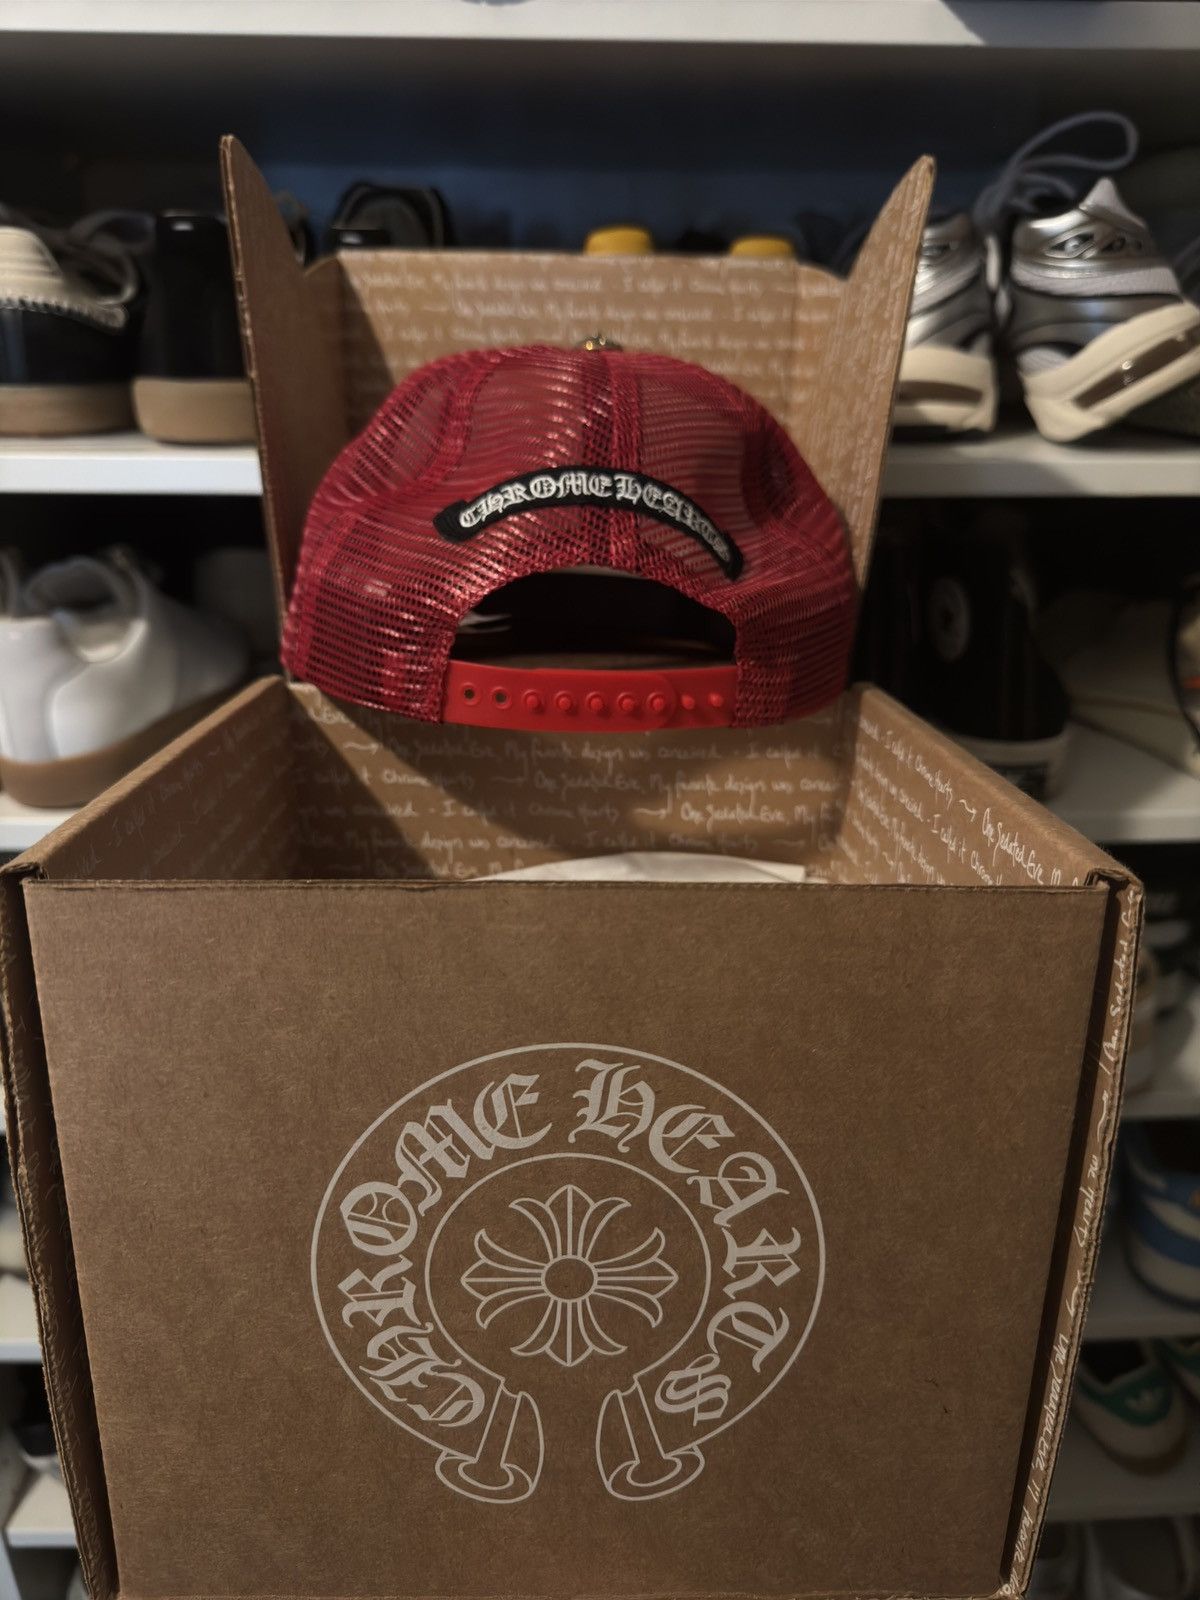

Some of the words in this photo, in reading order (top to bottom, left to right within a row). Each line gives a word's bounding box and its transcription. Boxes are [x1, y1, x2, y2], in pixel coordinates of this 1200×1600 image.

[458, 472, 613, 528] CHROME
[337, 1072, 553, 1427] CHROME
[567, 1058, 802, 1427] HEARTS
